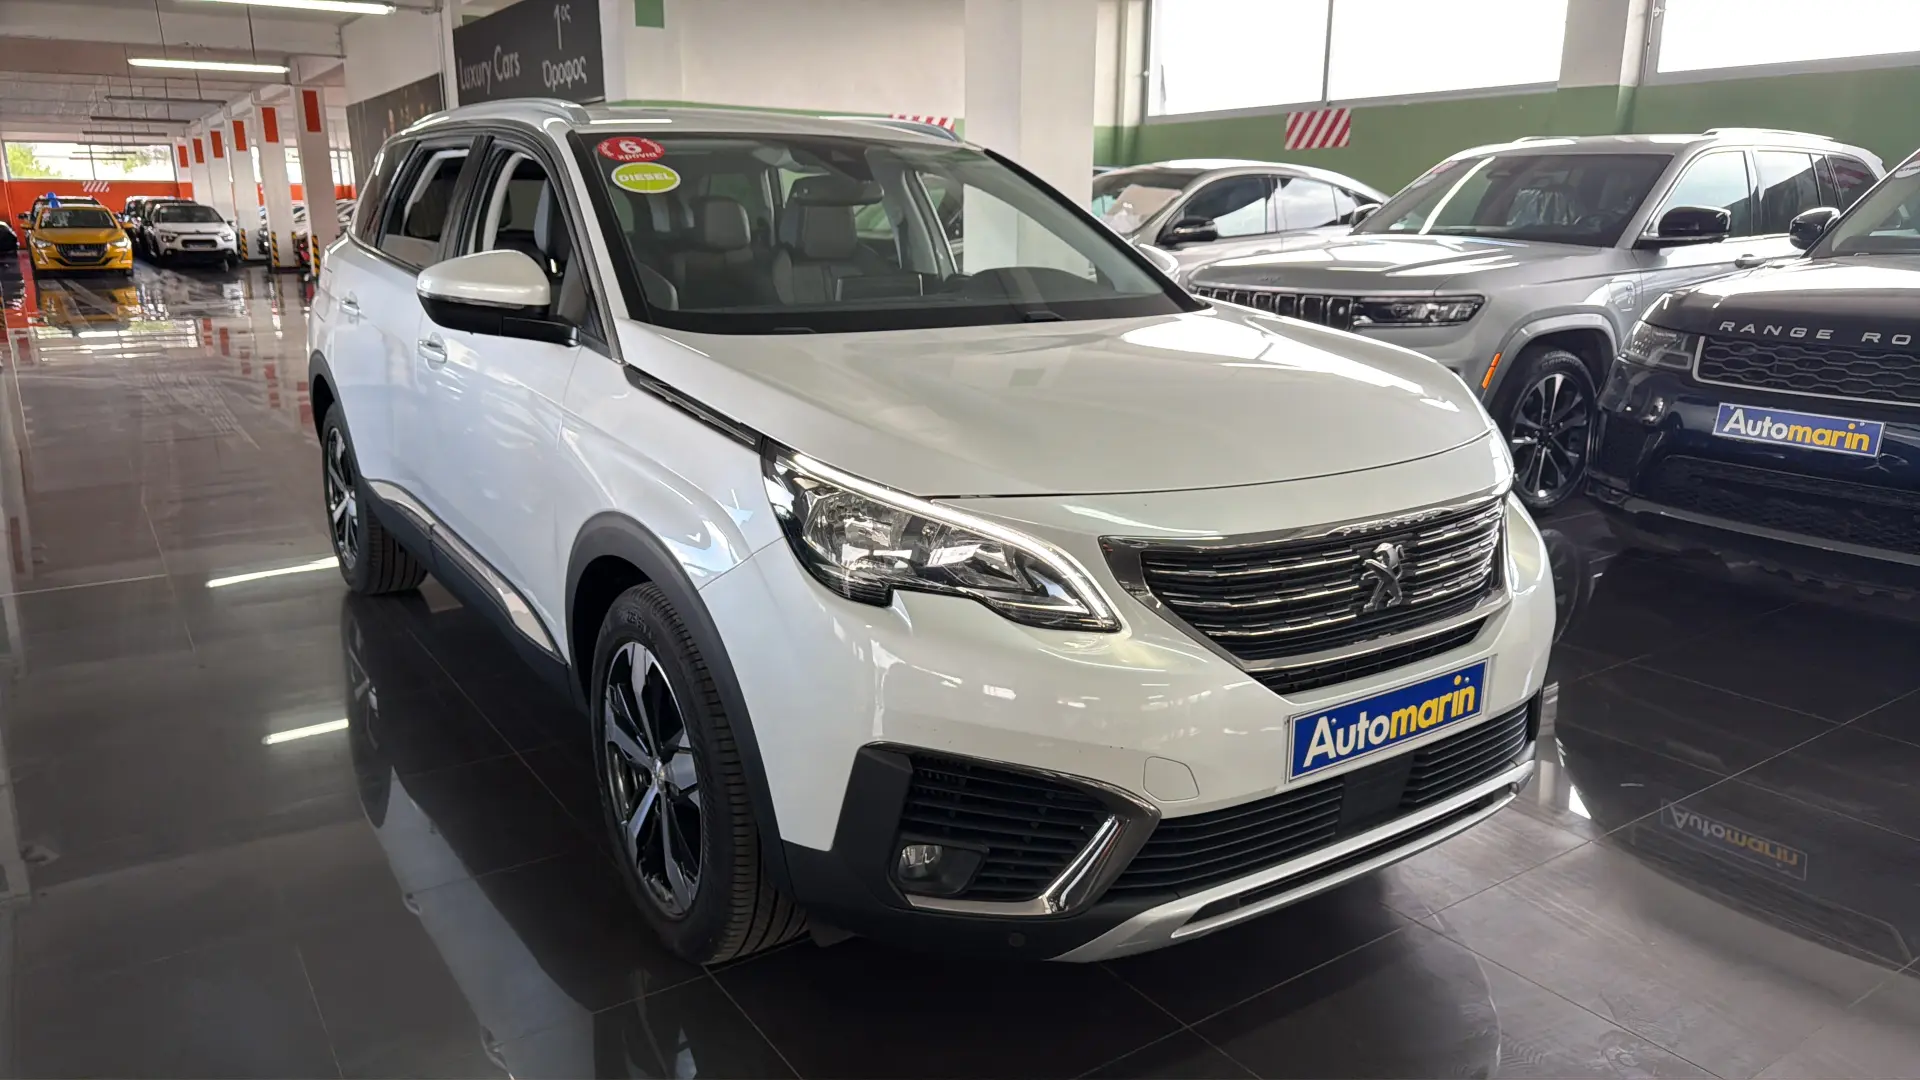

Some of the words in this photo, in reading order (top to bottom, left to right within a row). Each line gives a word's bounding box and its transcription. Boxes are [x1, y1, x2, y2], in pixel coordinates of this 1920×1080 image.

[458, 57, 492, 95] Luxury
[493, 44, 521, 82] Cars
[618, 140, 642, 154] 6
[617, 172, 675, 183] DIESEL
[1718, 321, 1835, 341] RANGE
[1722, 408, 1871, 452] Automarin
[1302, 675, 1476, 768] Automarin
